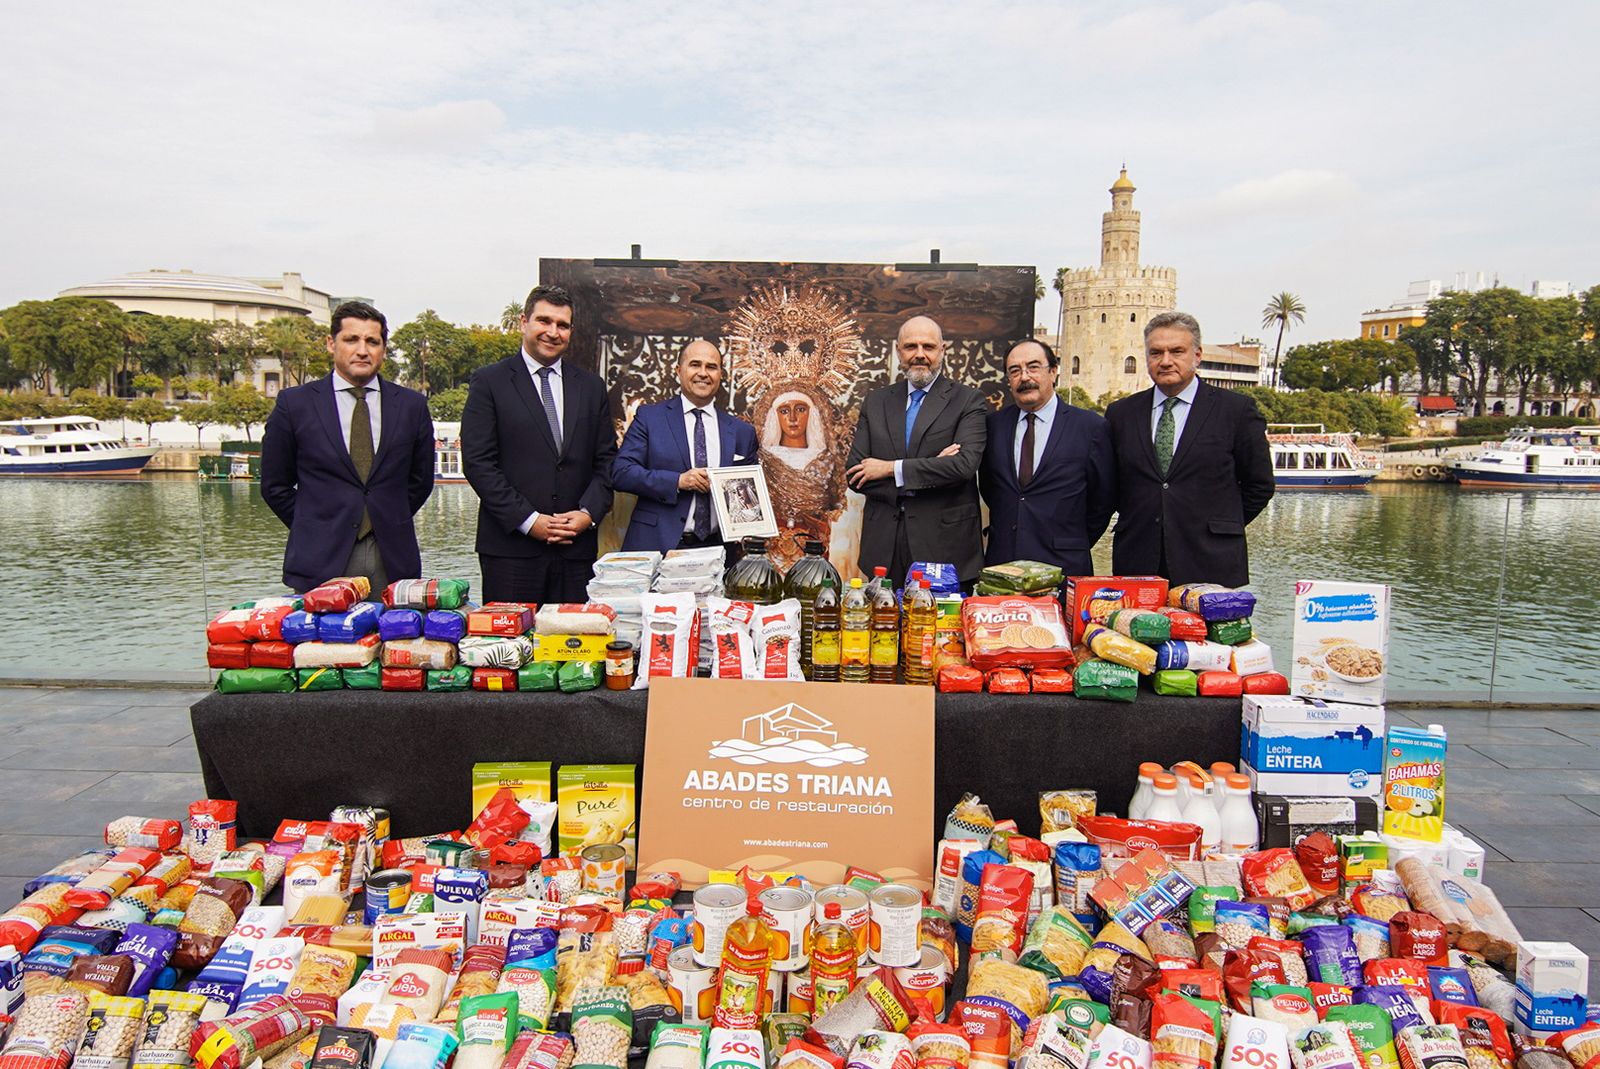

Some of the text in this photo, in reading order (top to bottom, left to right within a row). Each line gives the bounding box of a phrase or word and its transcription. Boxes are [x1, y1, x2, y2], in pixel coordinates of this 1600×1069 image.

[1306, 600, 1324, 618] 0%
[1266, 744, 1292, 754] Leche
[1266, 754, 1322, 769] ENTERA
[1389, 762, 1442, 781] BAHAMAS
[683, 770, 893, 797] ABADES TRIANA
[1392, 784, 1436, 801] 2 LITROS
[576, 798, 618, 815] Puré
[682, 797, 894, 815] centro de restauración
[743, 838, 829, 848] www.abadestriana.com
[1128, 840, 1157, 850] Cuétara
[436, 884, 474, 896] PULEVA
[486, 911, 516, 924] ARGAL
[132, 934, 147, 944] LA
[380, 931, 414, 942] ARGAL
[115, 942, 157, 958] CIGALA
[96, 964, 120, 972] EXTRA
[253, 957, 294, 972] SOS
[84, 972, 116, 983] LENTEJA
[508, 970, 538, 980] PEDRO
[1390, 968, 1406, 977] LA
[188, 986, 236, 1001] CIGALA
[206, 983, 220, 992] LA
[879, 986, 905, 1020] LENTEJA
[1276, 999, 1307, 1010] PEDRO
[1392, 995, 1406, 1004] LA
[577, 1002, 614, 1013] Garbanzo
[874, 991, 899, 1024] PARDINA
[972, 1006, 999, 1020] eliges
[1535, 1008, 1554, 1016] Leche
[1534, 1016, 1575, 1026] ENTERA
[319, 1047, 357, 1062] SAIMAZA
[721, 1042, 760, 1059] SOS
[1230, 1045, 1278, 1069] SOS
[1105, 1051, 1145, 1069] SO
